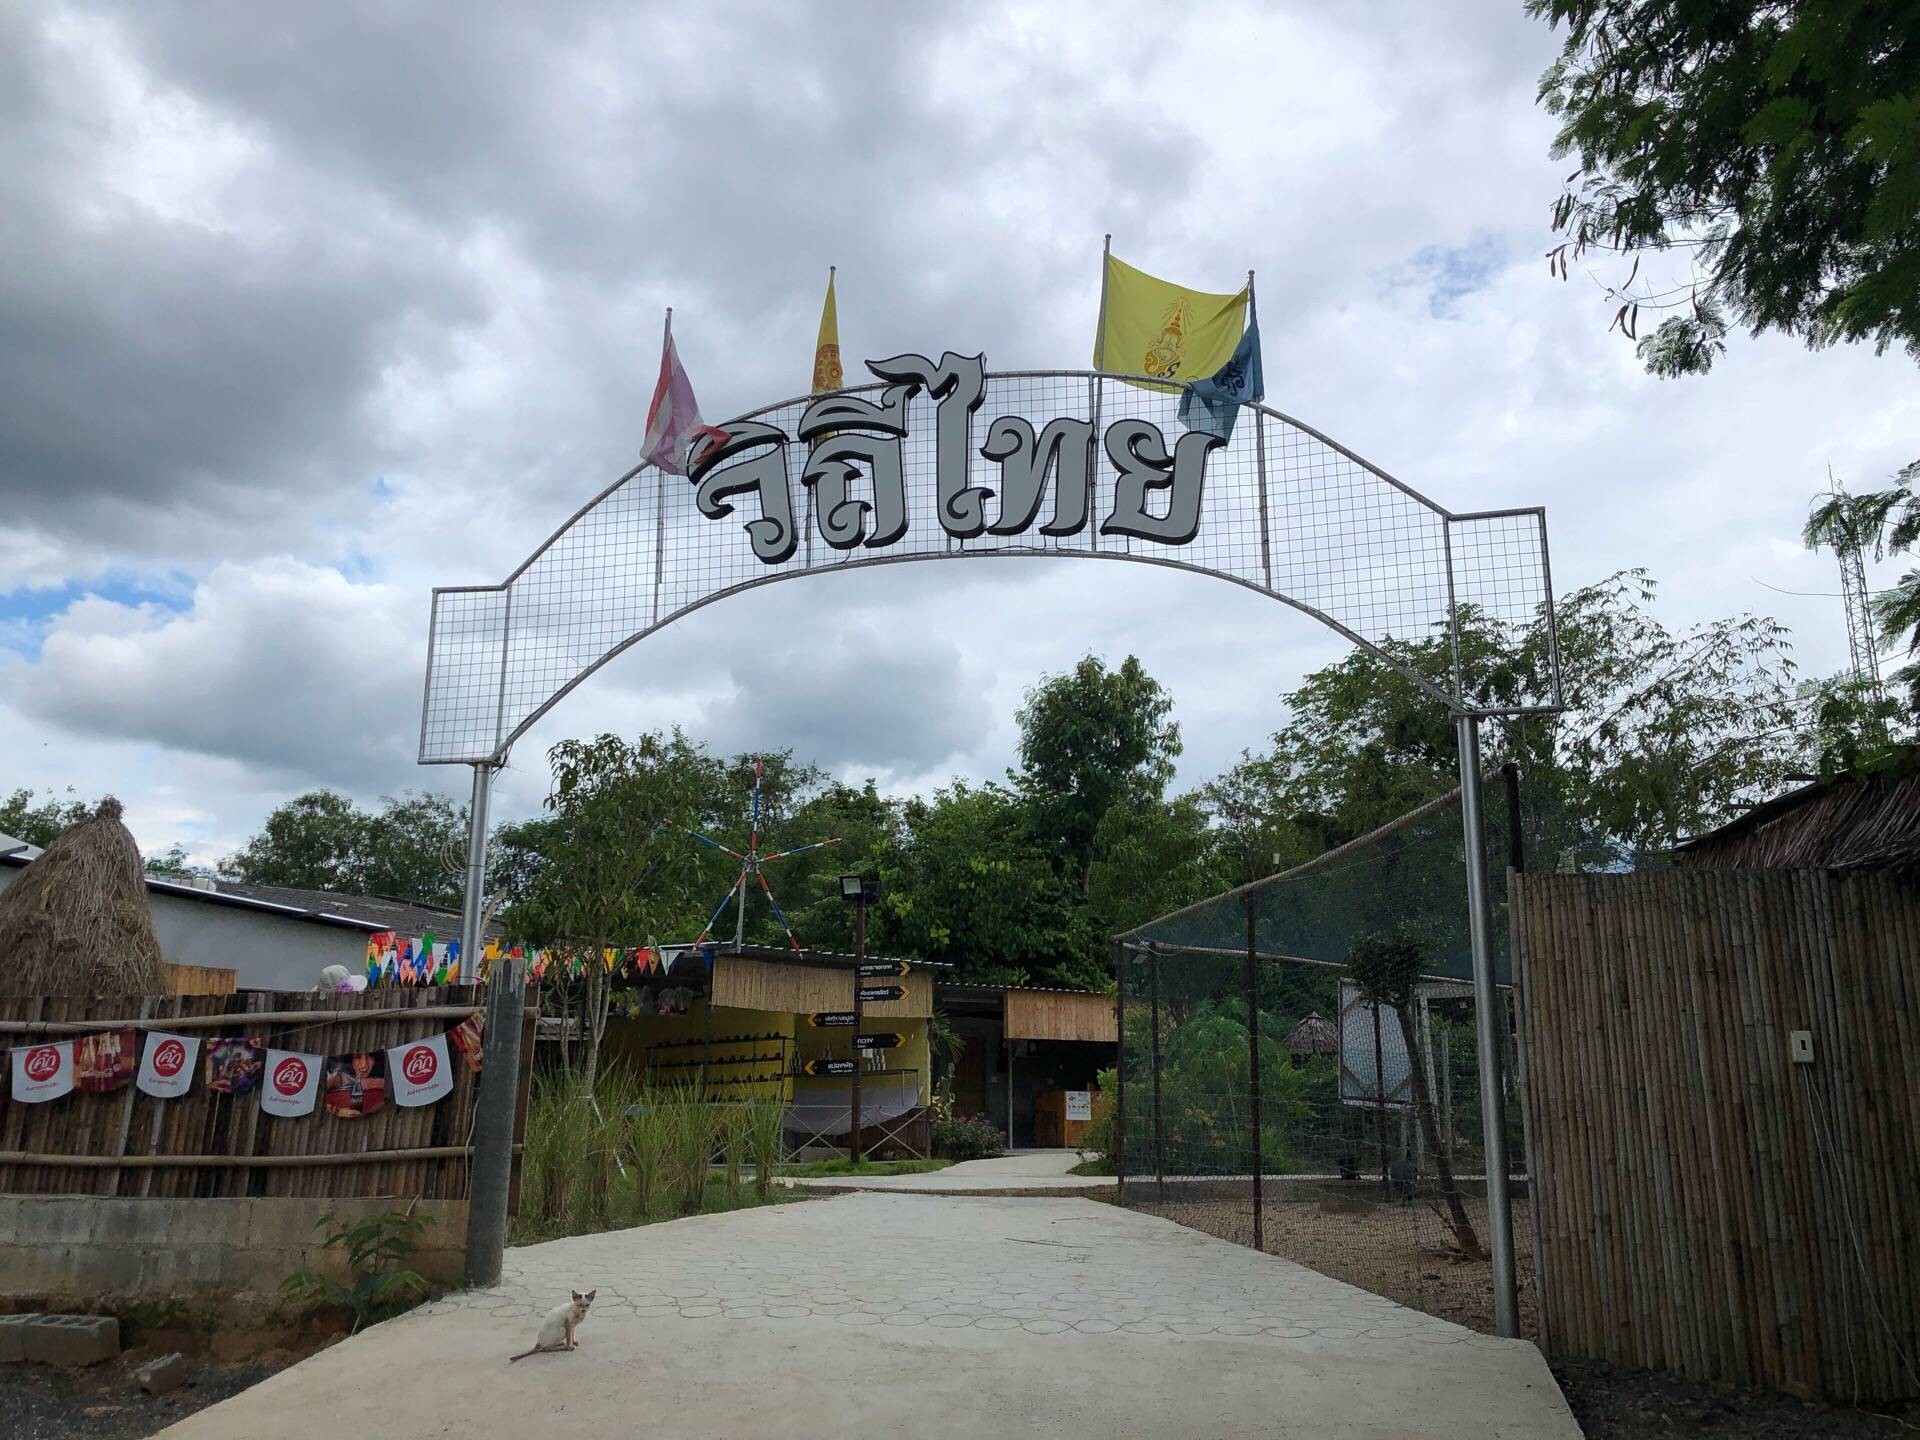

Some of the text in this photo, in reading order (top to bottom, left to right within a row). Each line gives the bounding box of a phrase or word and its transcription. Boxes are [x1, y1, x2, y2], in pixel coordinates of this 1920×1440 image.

[687, 351, 1228, 565] วิถีไทย
[28, 1048, 56, 1075] โค้ก
[155, 1044, 182, 1074] โค้ก
[406, 1049, 434, 1078] โค้ก
[276, 1062, 304, 1090] โค้ก
